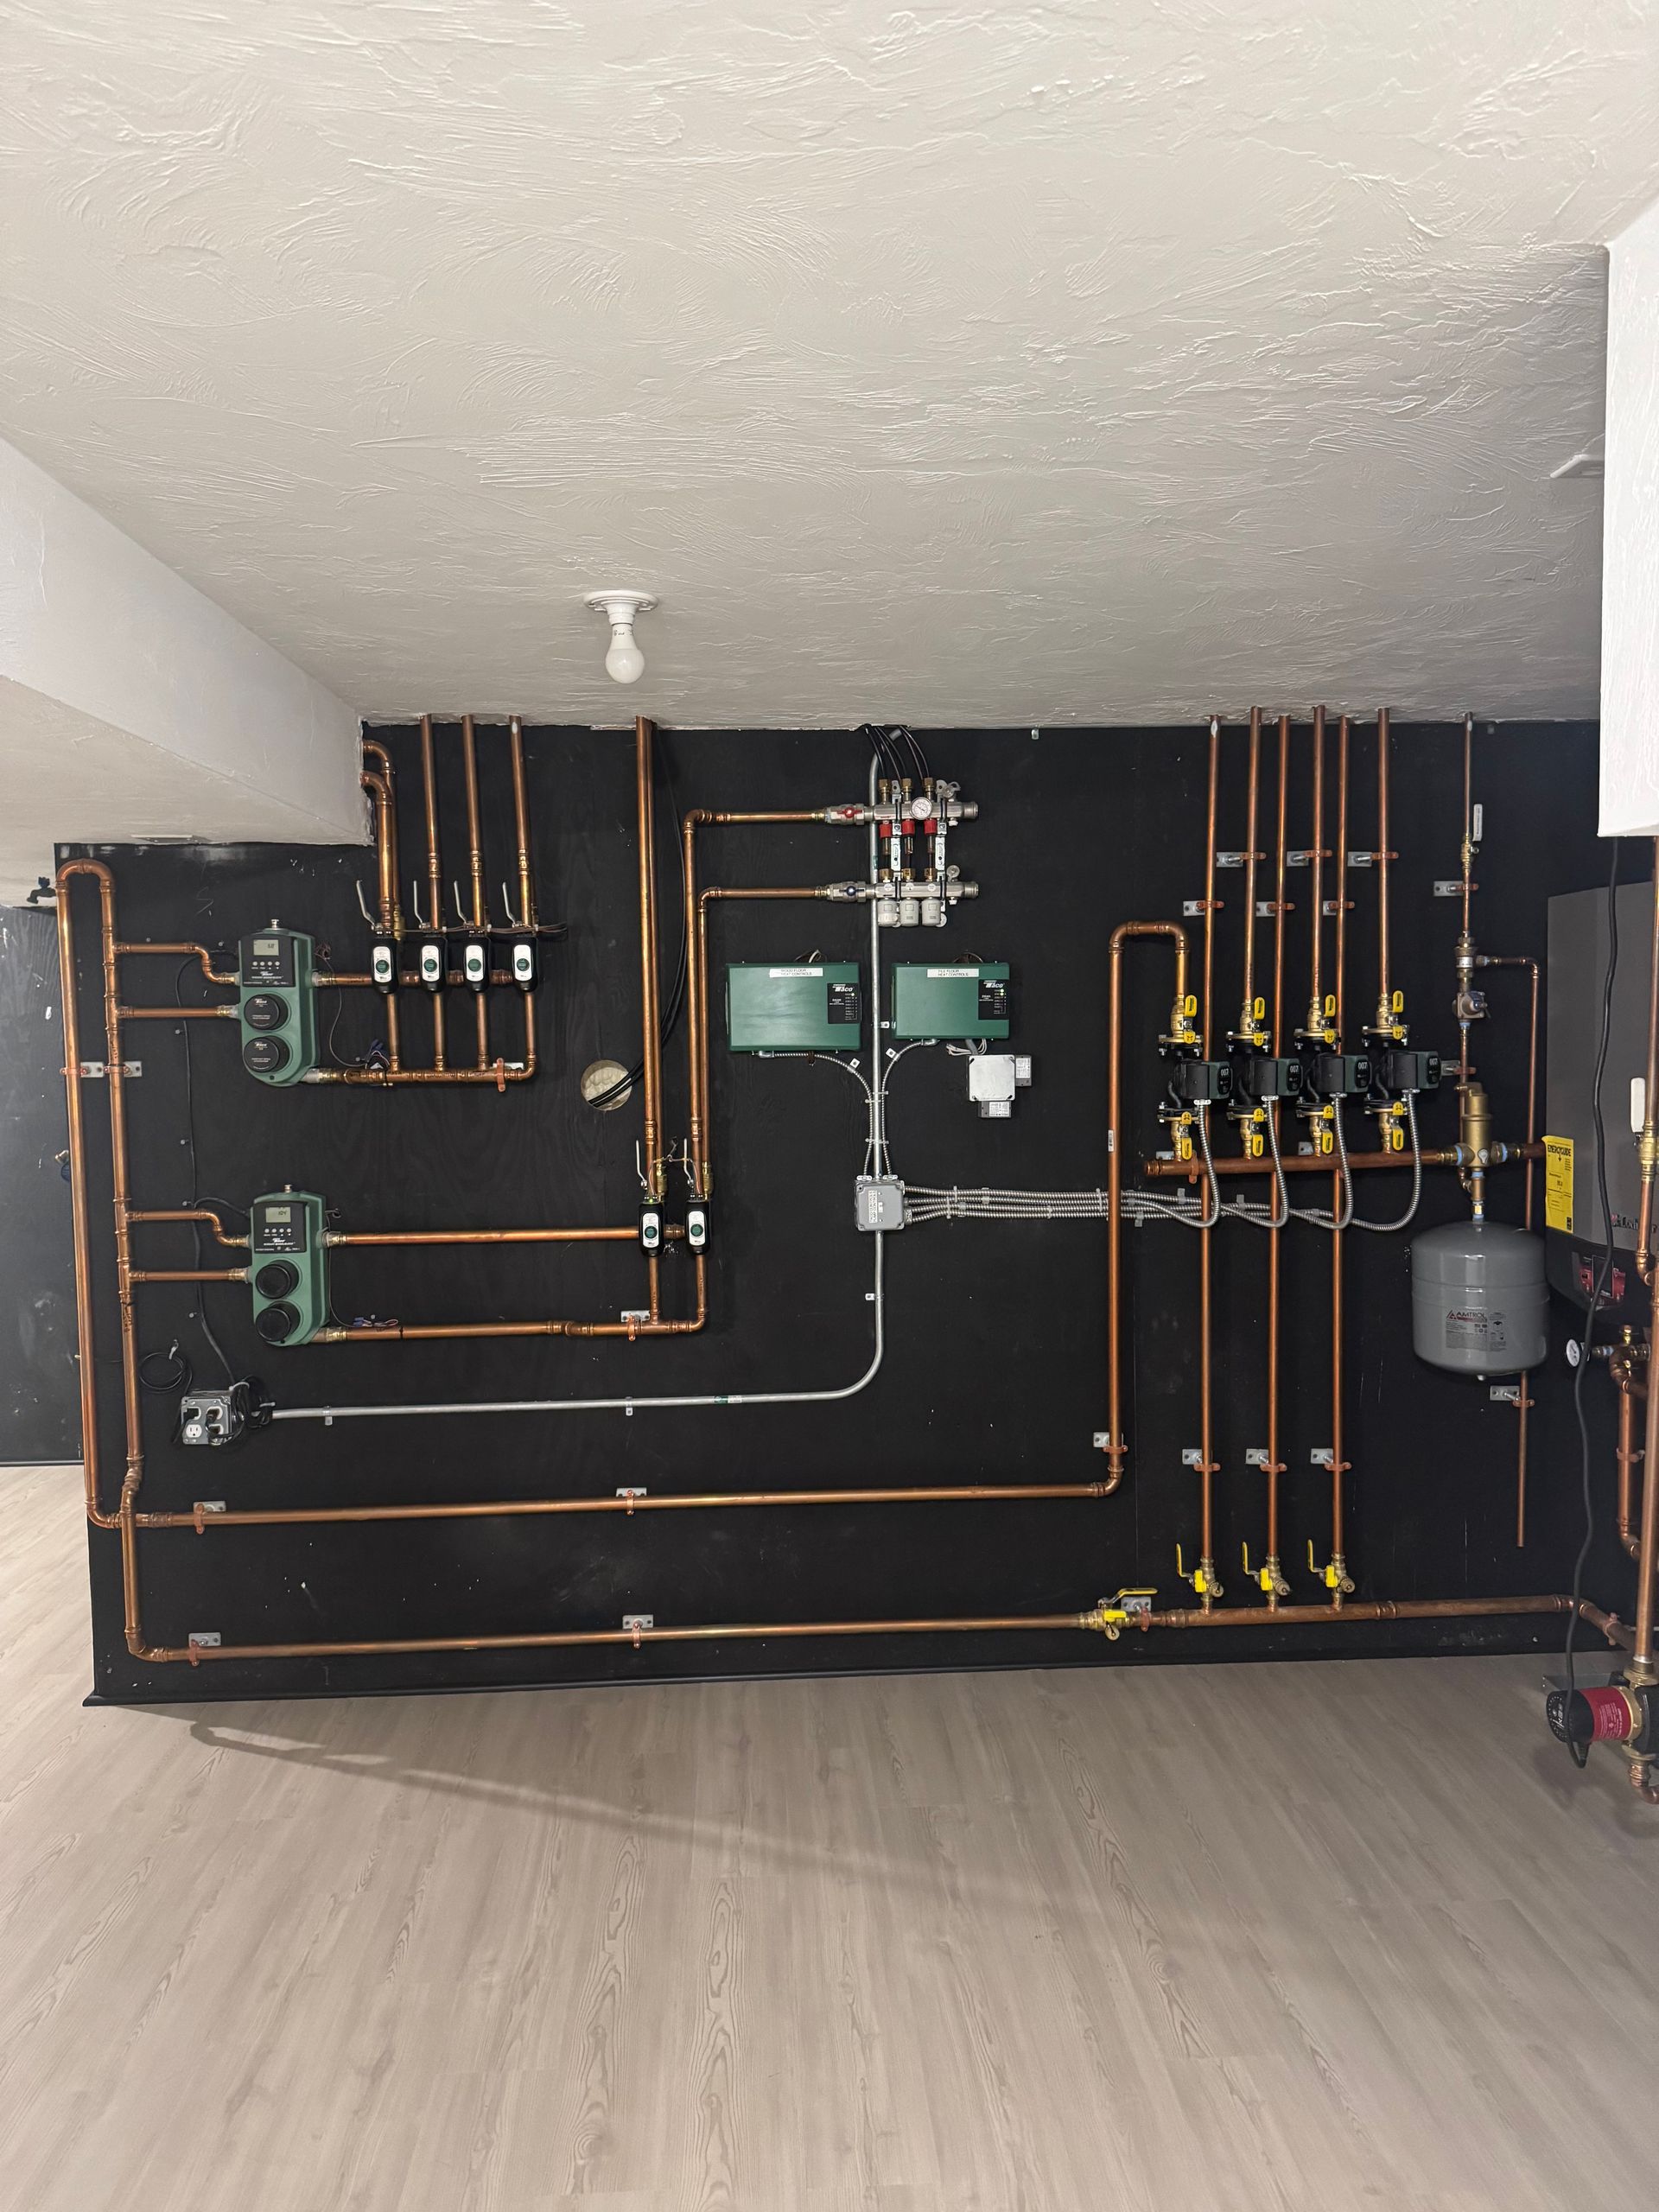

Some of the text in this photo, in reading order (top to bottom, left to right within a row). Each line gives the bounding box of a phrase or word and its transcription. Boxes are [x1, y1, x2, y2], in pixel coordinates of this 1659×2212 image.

[1289, 1065, 1299, 1073] 007
[1357, 1061, 1368, 1070] 007
[1220, 1068, 1229, 1077] 007
